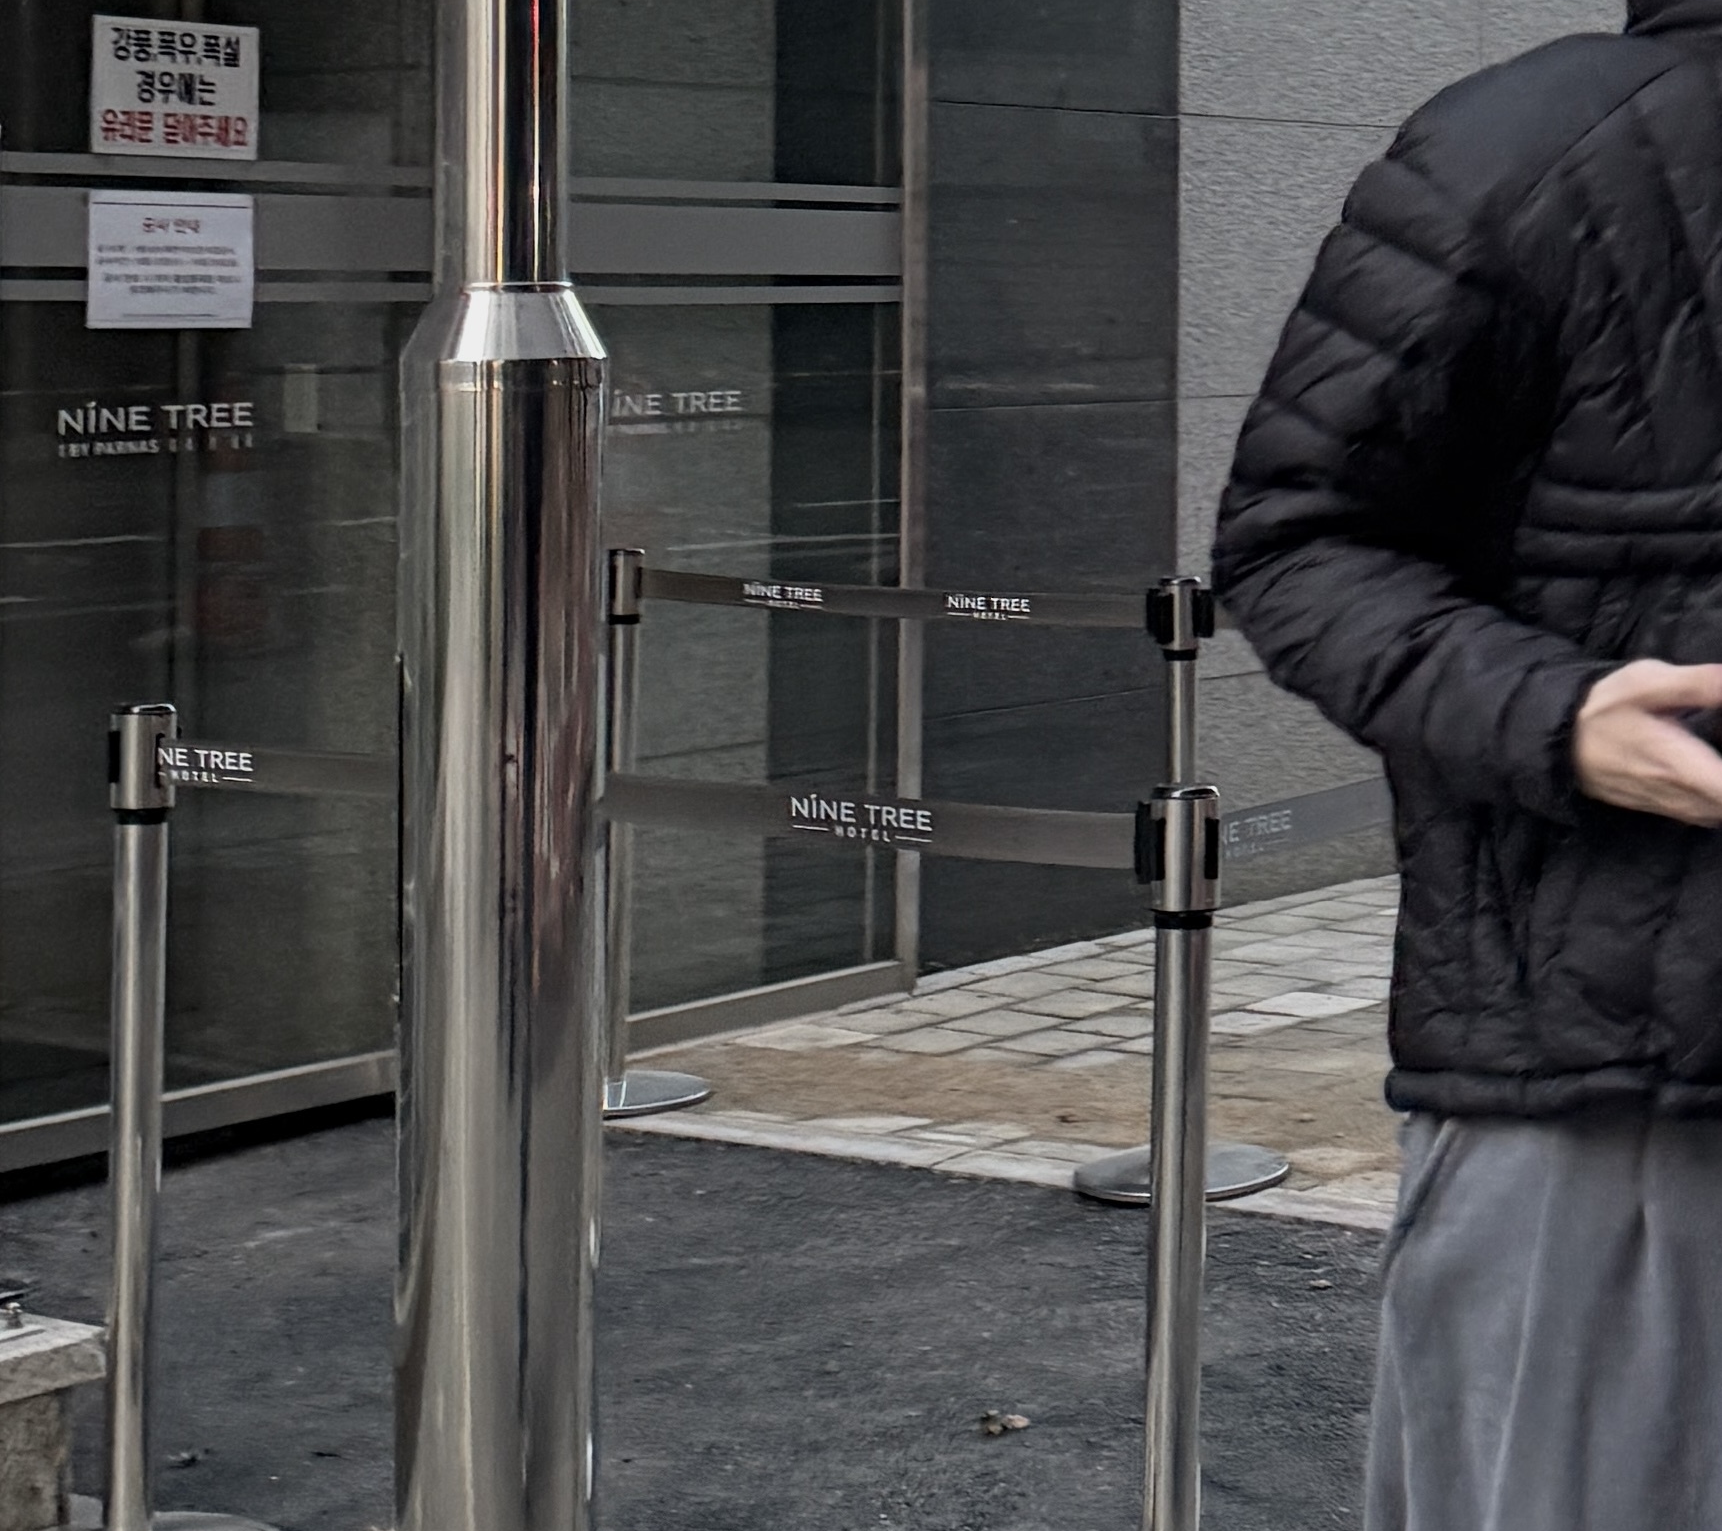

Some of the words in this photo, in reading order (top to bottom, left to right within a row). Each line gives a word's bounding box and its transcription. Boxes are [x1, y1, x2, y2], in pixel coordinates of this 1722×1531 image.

[670, 390, 744, 414] TREE
[160, 402, 254, 430] TREE
[784, 585, 824, 602] TREE
[990, 597, 1031, 612] TREE
[193, 749, 254, 772] TREE
[864, 804, 933, 832] TREE
[834, 824, 891, 843] HOTEL
